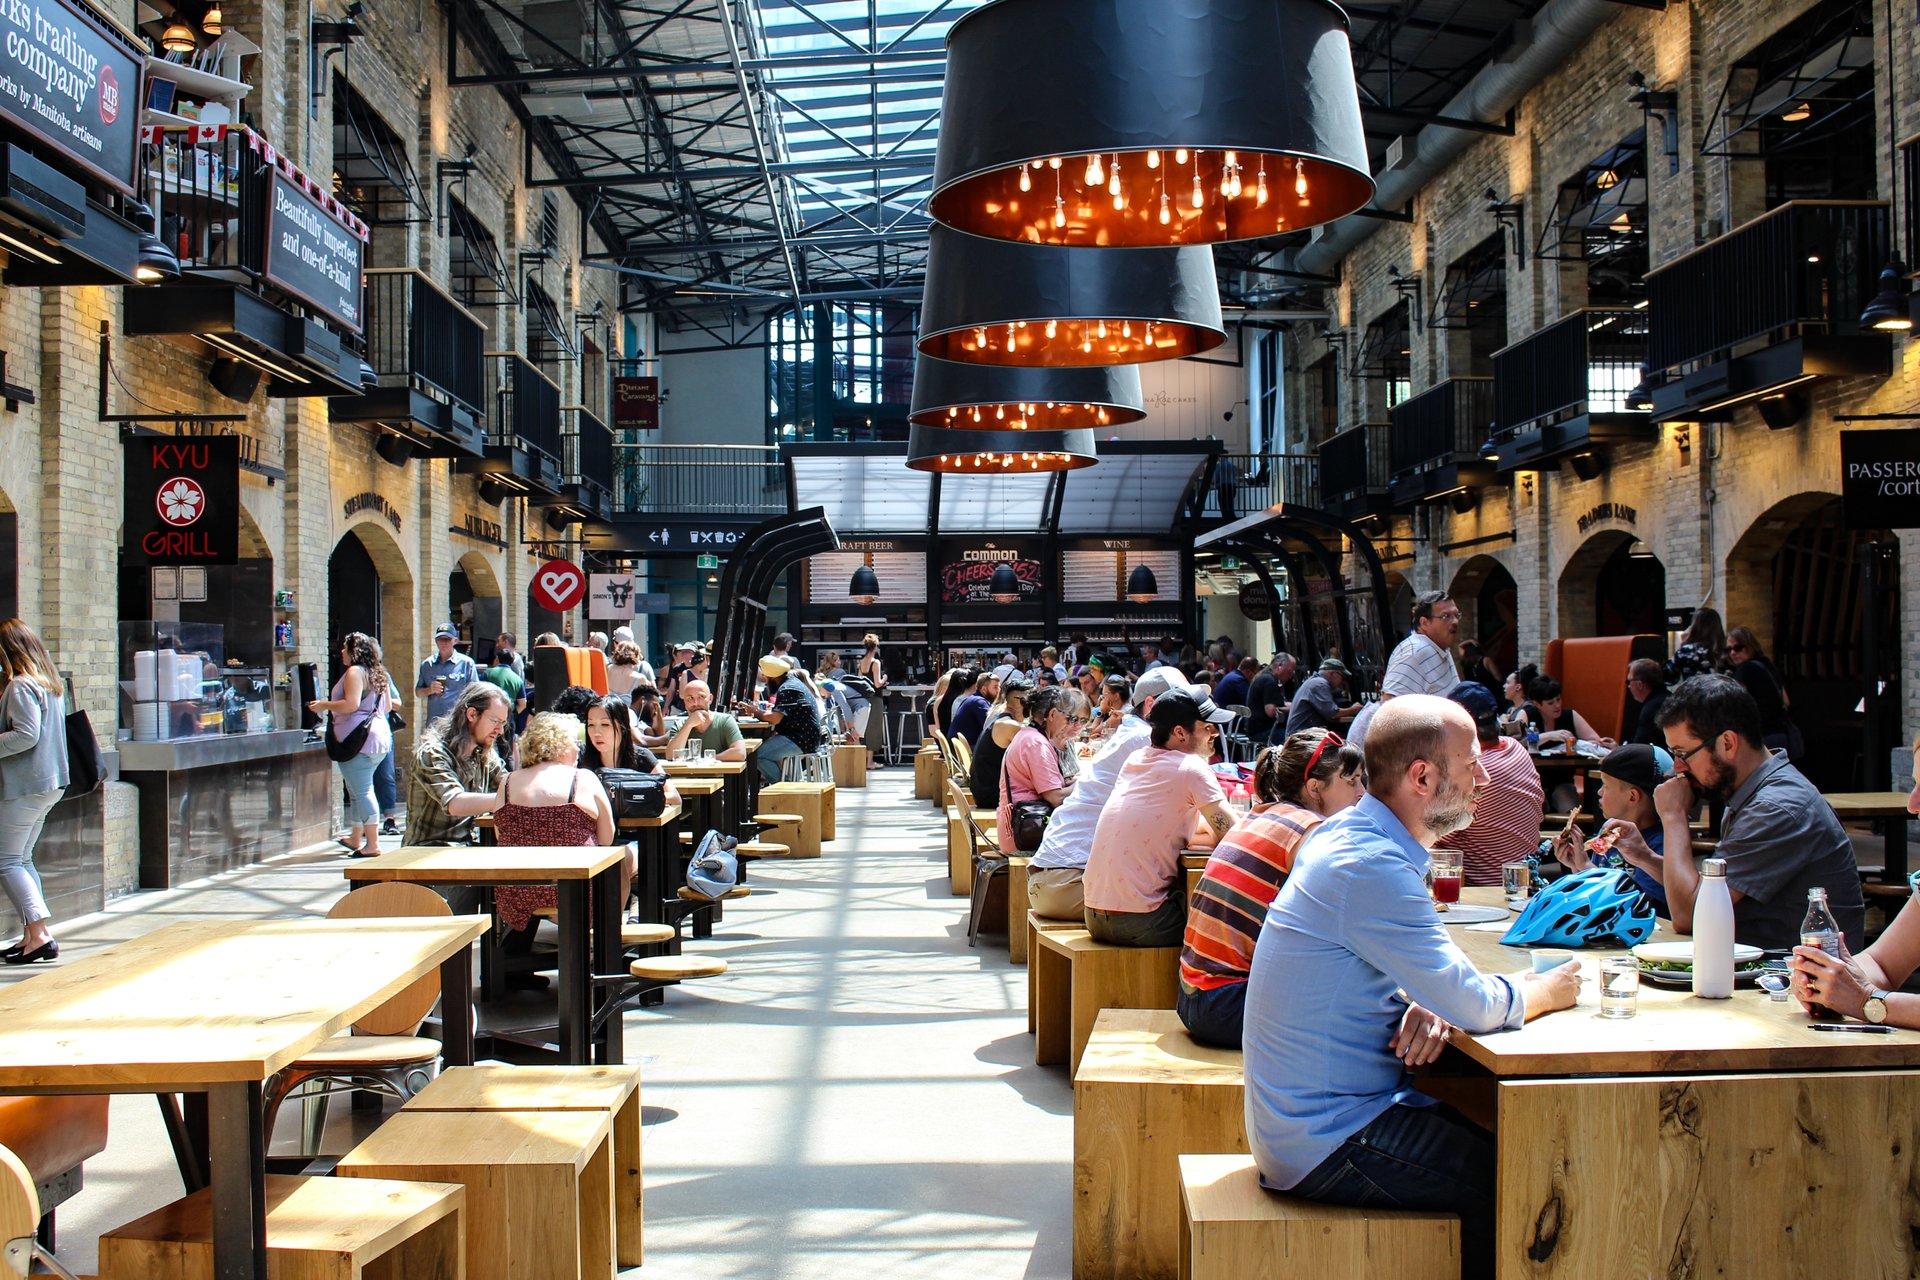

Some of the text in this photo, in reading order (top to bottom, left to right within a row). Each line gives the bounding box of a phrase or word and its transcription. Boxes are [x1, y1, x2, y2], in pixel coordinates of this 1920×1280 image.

[35, 6, 98, 89] trading
[7, 31, 89, 113] company
[102, 81, 119, 108] MB
[19, 85, 32, 109] by
[32, 93, 71, 133] Manitoba
[72, 123, 103, 152] artisans
[275, 186, 359, 268] Beautifully imperfect
[282, 231, 352, 293] and one-of-a-kind
[152, 444, 210, 469] KYU
[1849, 460, 1920, 479] PASSER
[142, 530, 218, 557] GRILL
[840, 541, 894, 550] RAFT BEER
[1103, 540, 1131, 549] WINE
